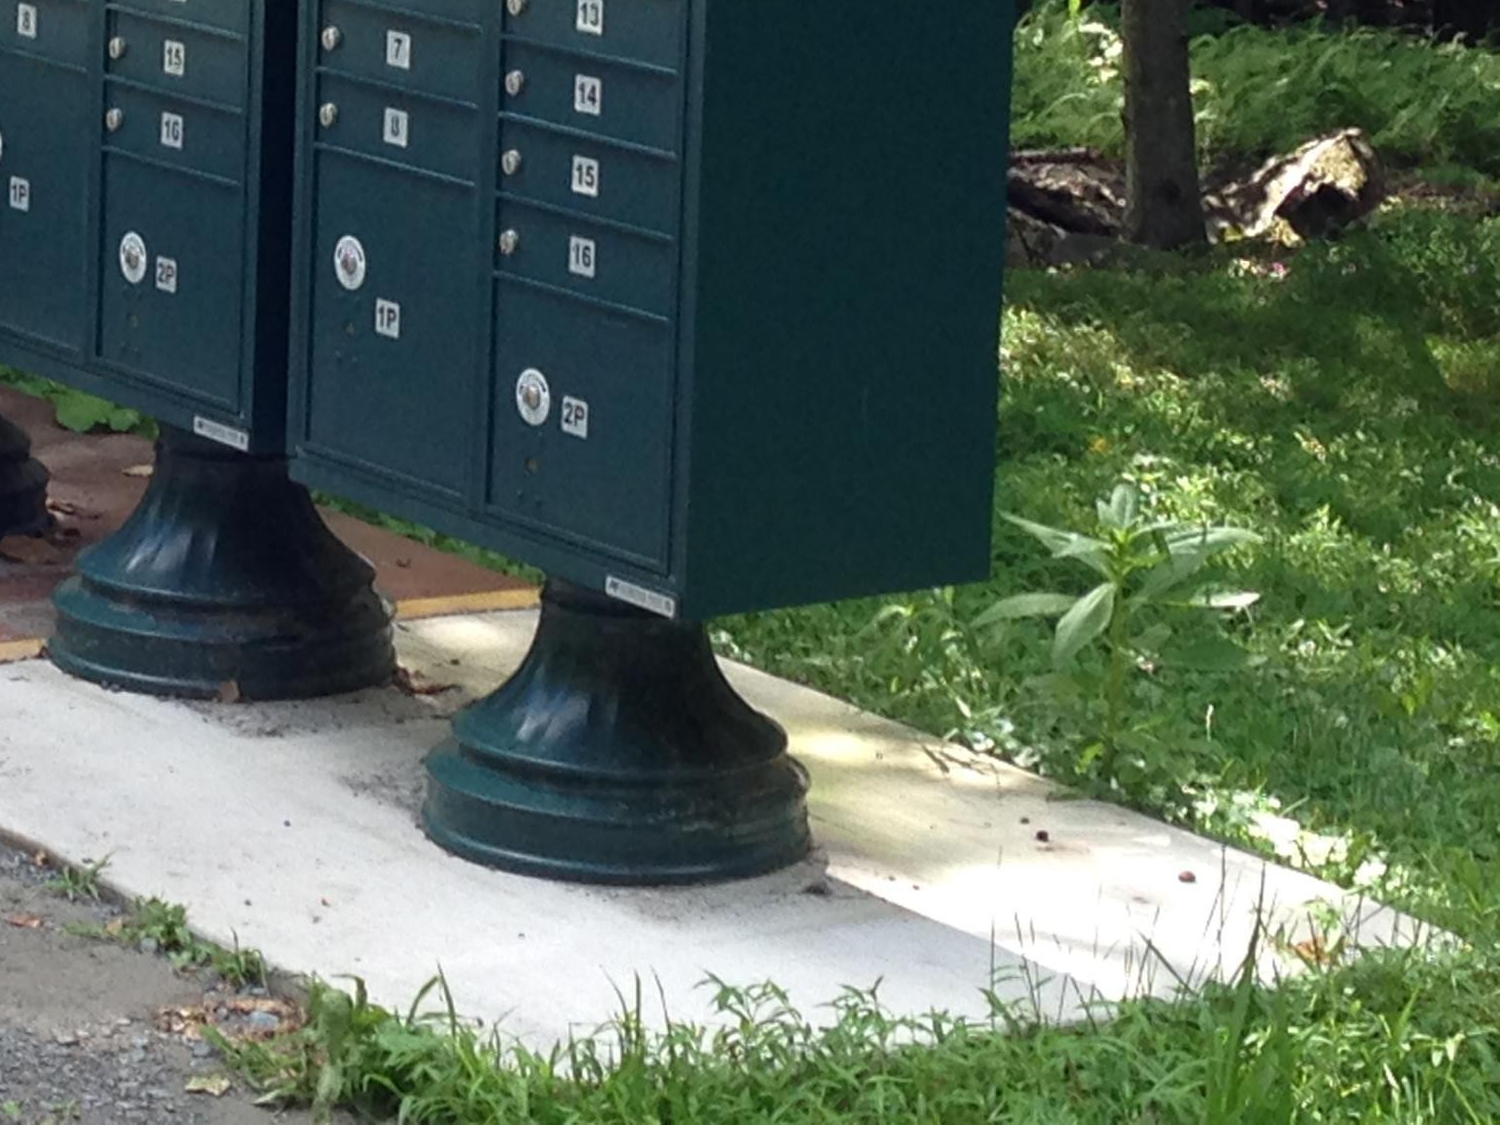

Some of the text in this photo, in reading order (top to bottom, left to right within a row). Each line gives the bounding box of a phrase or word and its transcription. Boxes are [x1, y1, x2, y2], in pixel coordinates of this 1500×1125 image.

[580, 2, 599, 27] 13
[578, 82, 597, 106] 14
[575, 163, 595, 188] 15
[572, 243, 592, 268] 16
[378, 306, 397, 329] 1P
[564, 402, 585, 426] 2P
